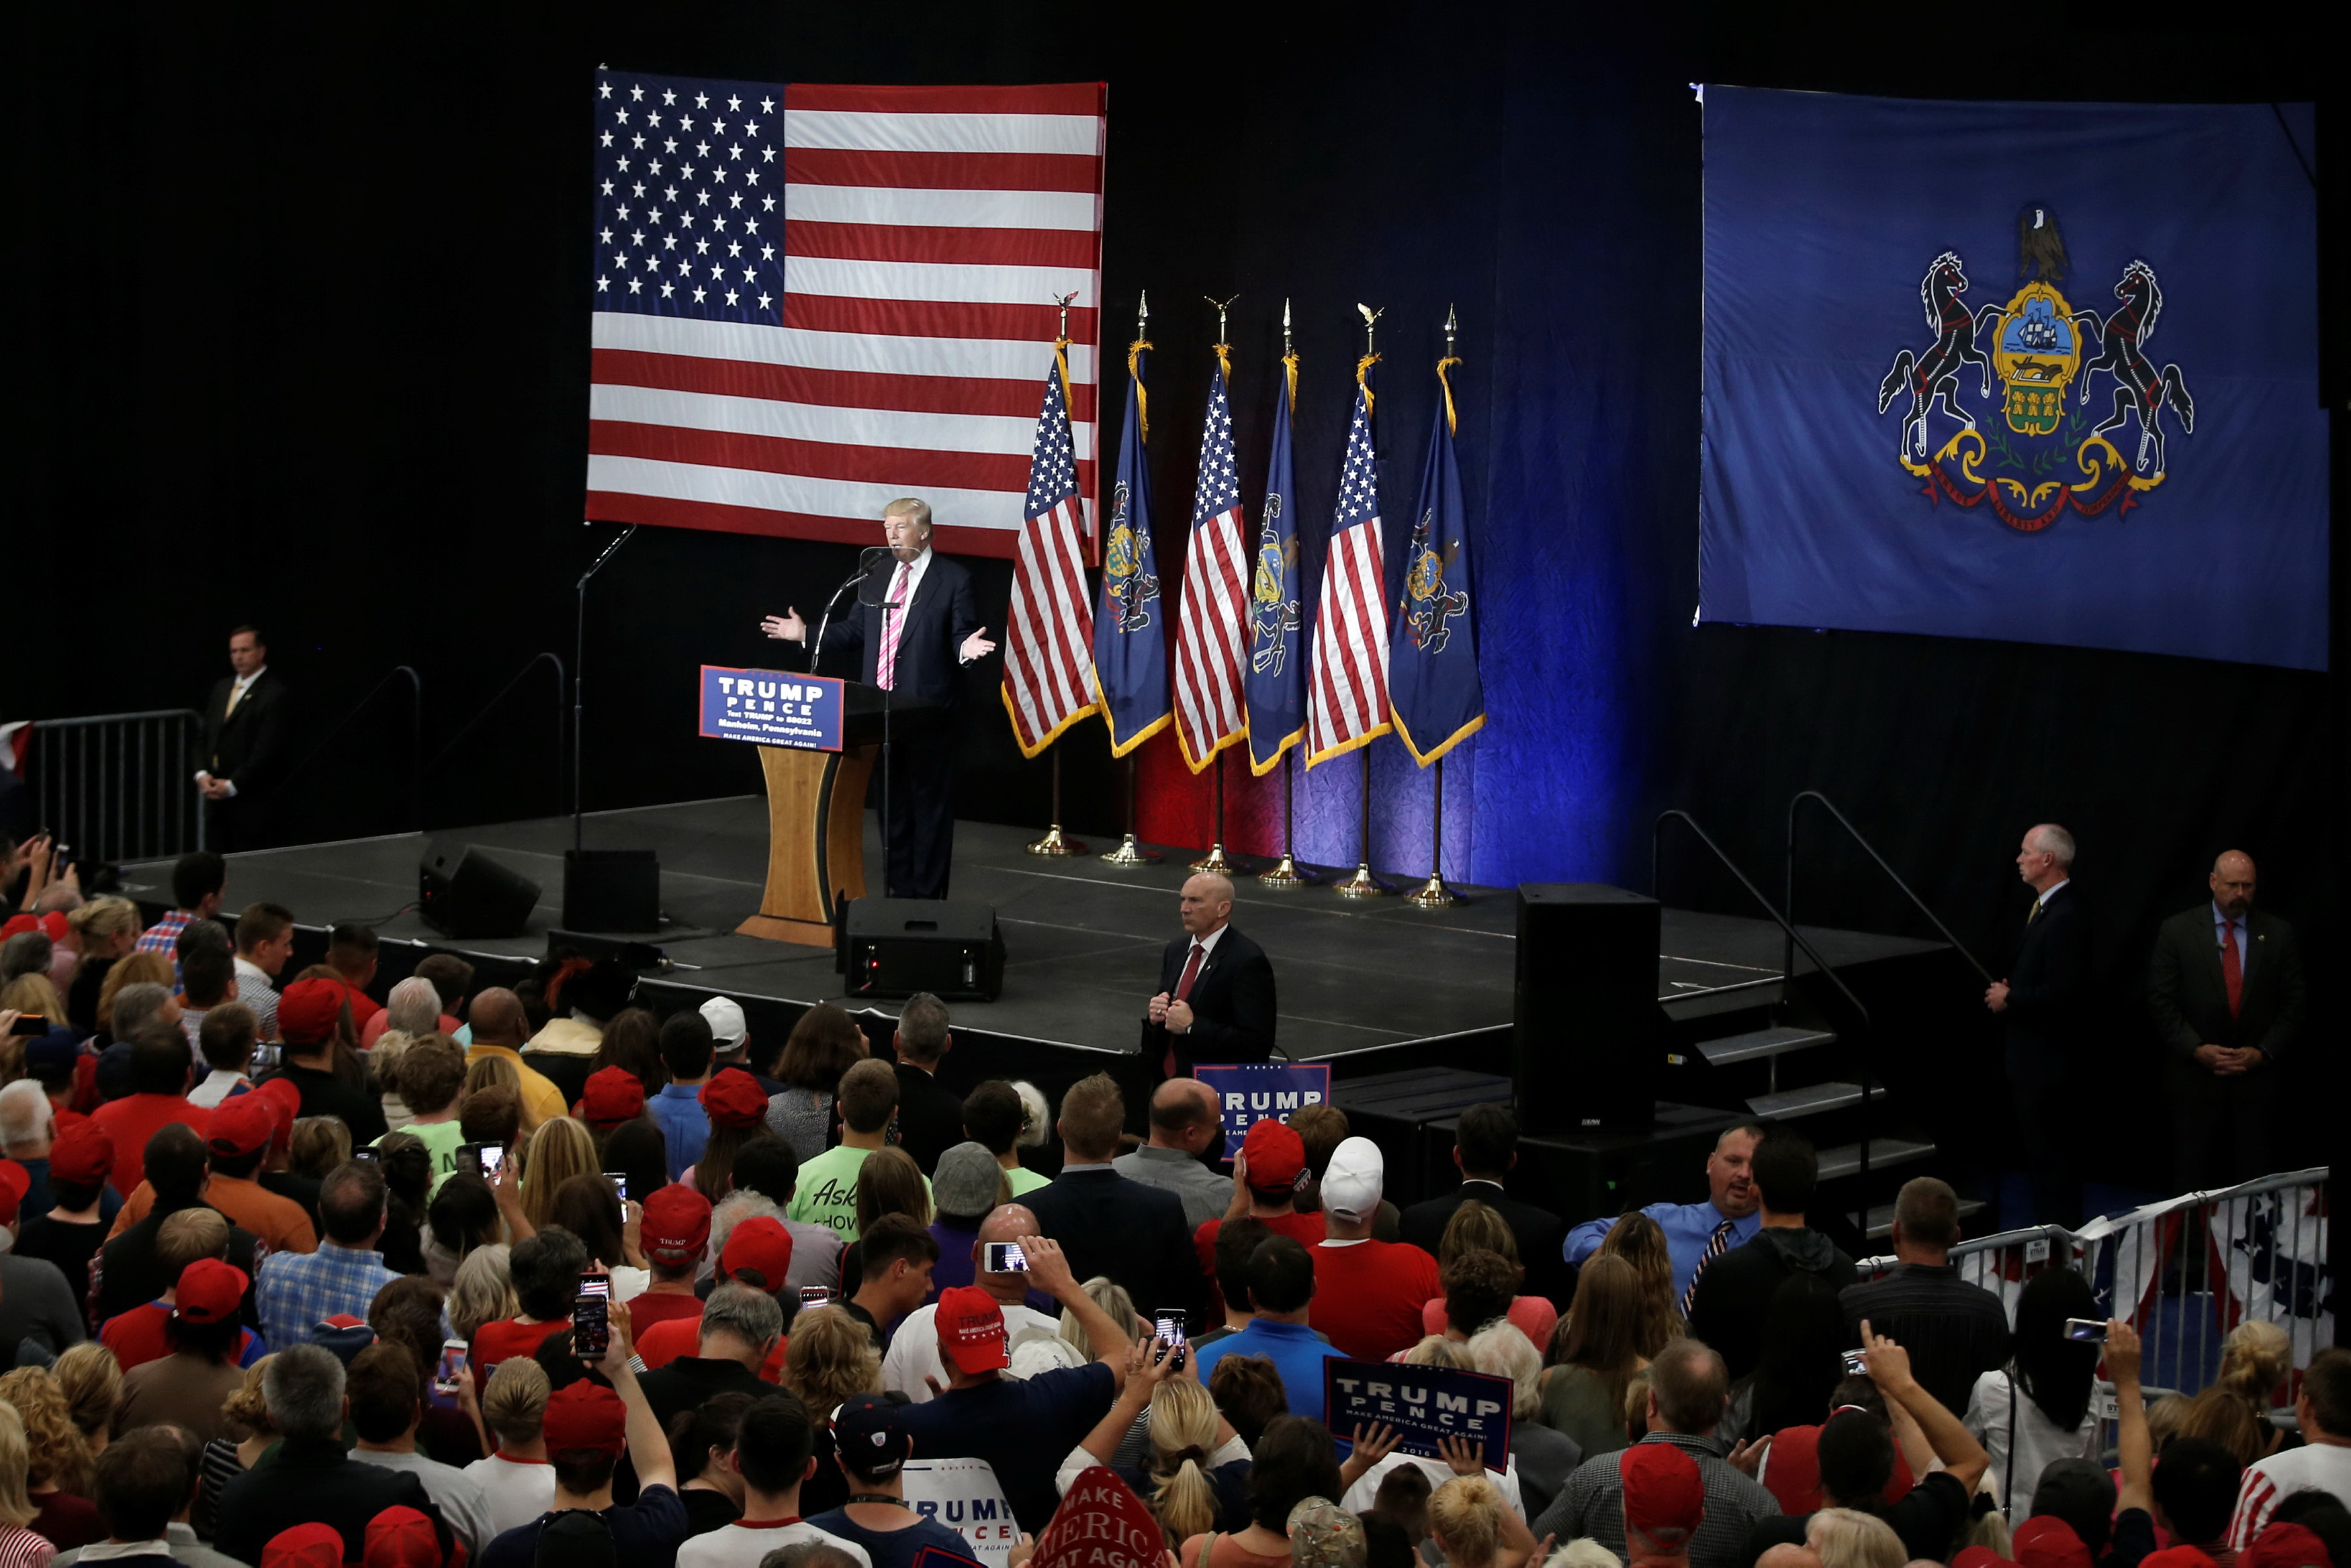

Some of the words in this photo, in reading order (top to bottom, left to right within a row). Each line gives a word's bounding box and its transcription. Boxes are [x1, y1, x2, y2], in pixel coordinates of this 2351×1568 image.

[1994, 500, 2036, 530] LIBERTY
[2041, 506, 2059, 526] AND
[718, 676, 824, 702] TRUMP
[726, 696, 812, 716] PENCE
[727, 710, 742, 718] Text
[744, 712, 774, 721] TRUMP
[718, 719, 760, 732] Manheim,
[762, 723, 822, 737] Pennsylvania
[742, 735, 770, 743] AMERICA
[1217, 1091, 1321, 1110] RUMP
[813, 1178, 856, 1207] Ask
[660, 1238, 686, 1246] TRUMP
[1336, 1378, 1501, 1416] TRUMP
[1351, 1397, 1483, 1430] PENCE
[1345, 1410, 1372, 1418] MAKE
[1375, 1414, 1417, 1426] AMERICA
[1420, 1424, 1451, 1434] GREAT
[1454, 1431, 1487, 1440] AGAIN!
[1402, 1447, 1431, 1457] 2016
[1063, 1487, 1124, 1514] MAKE
[1089, 1547, 1147, 1568] AGA
